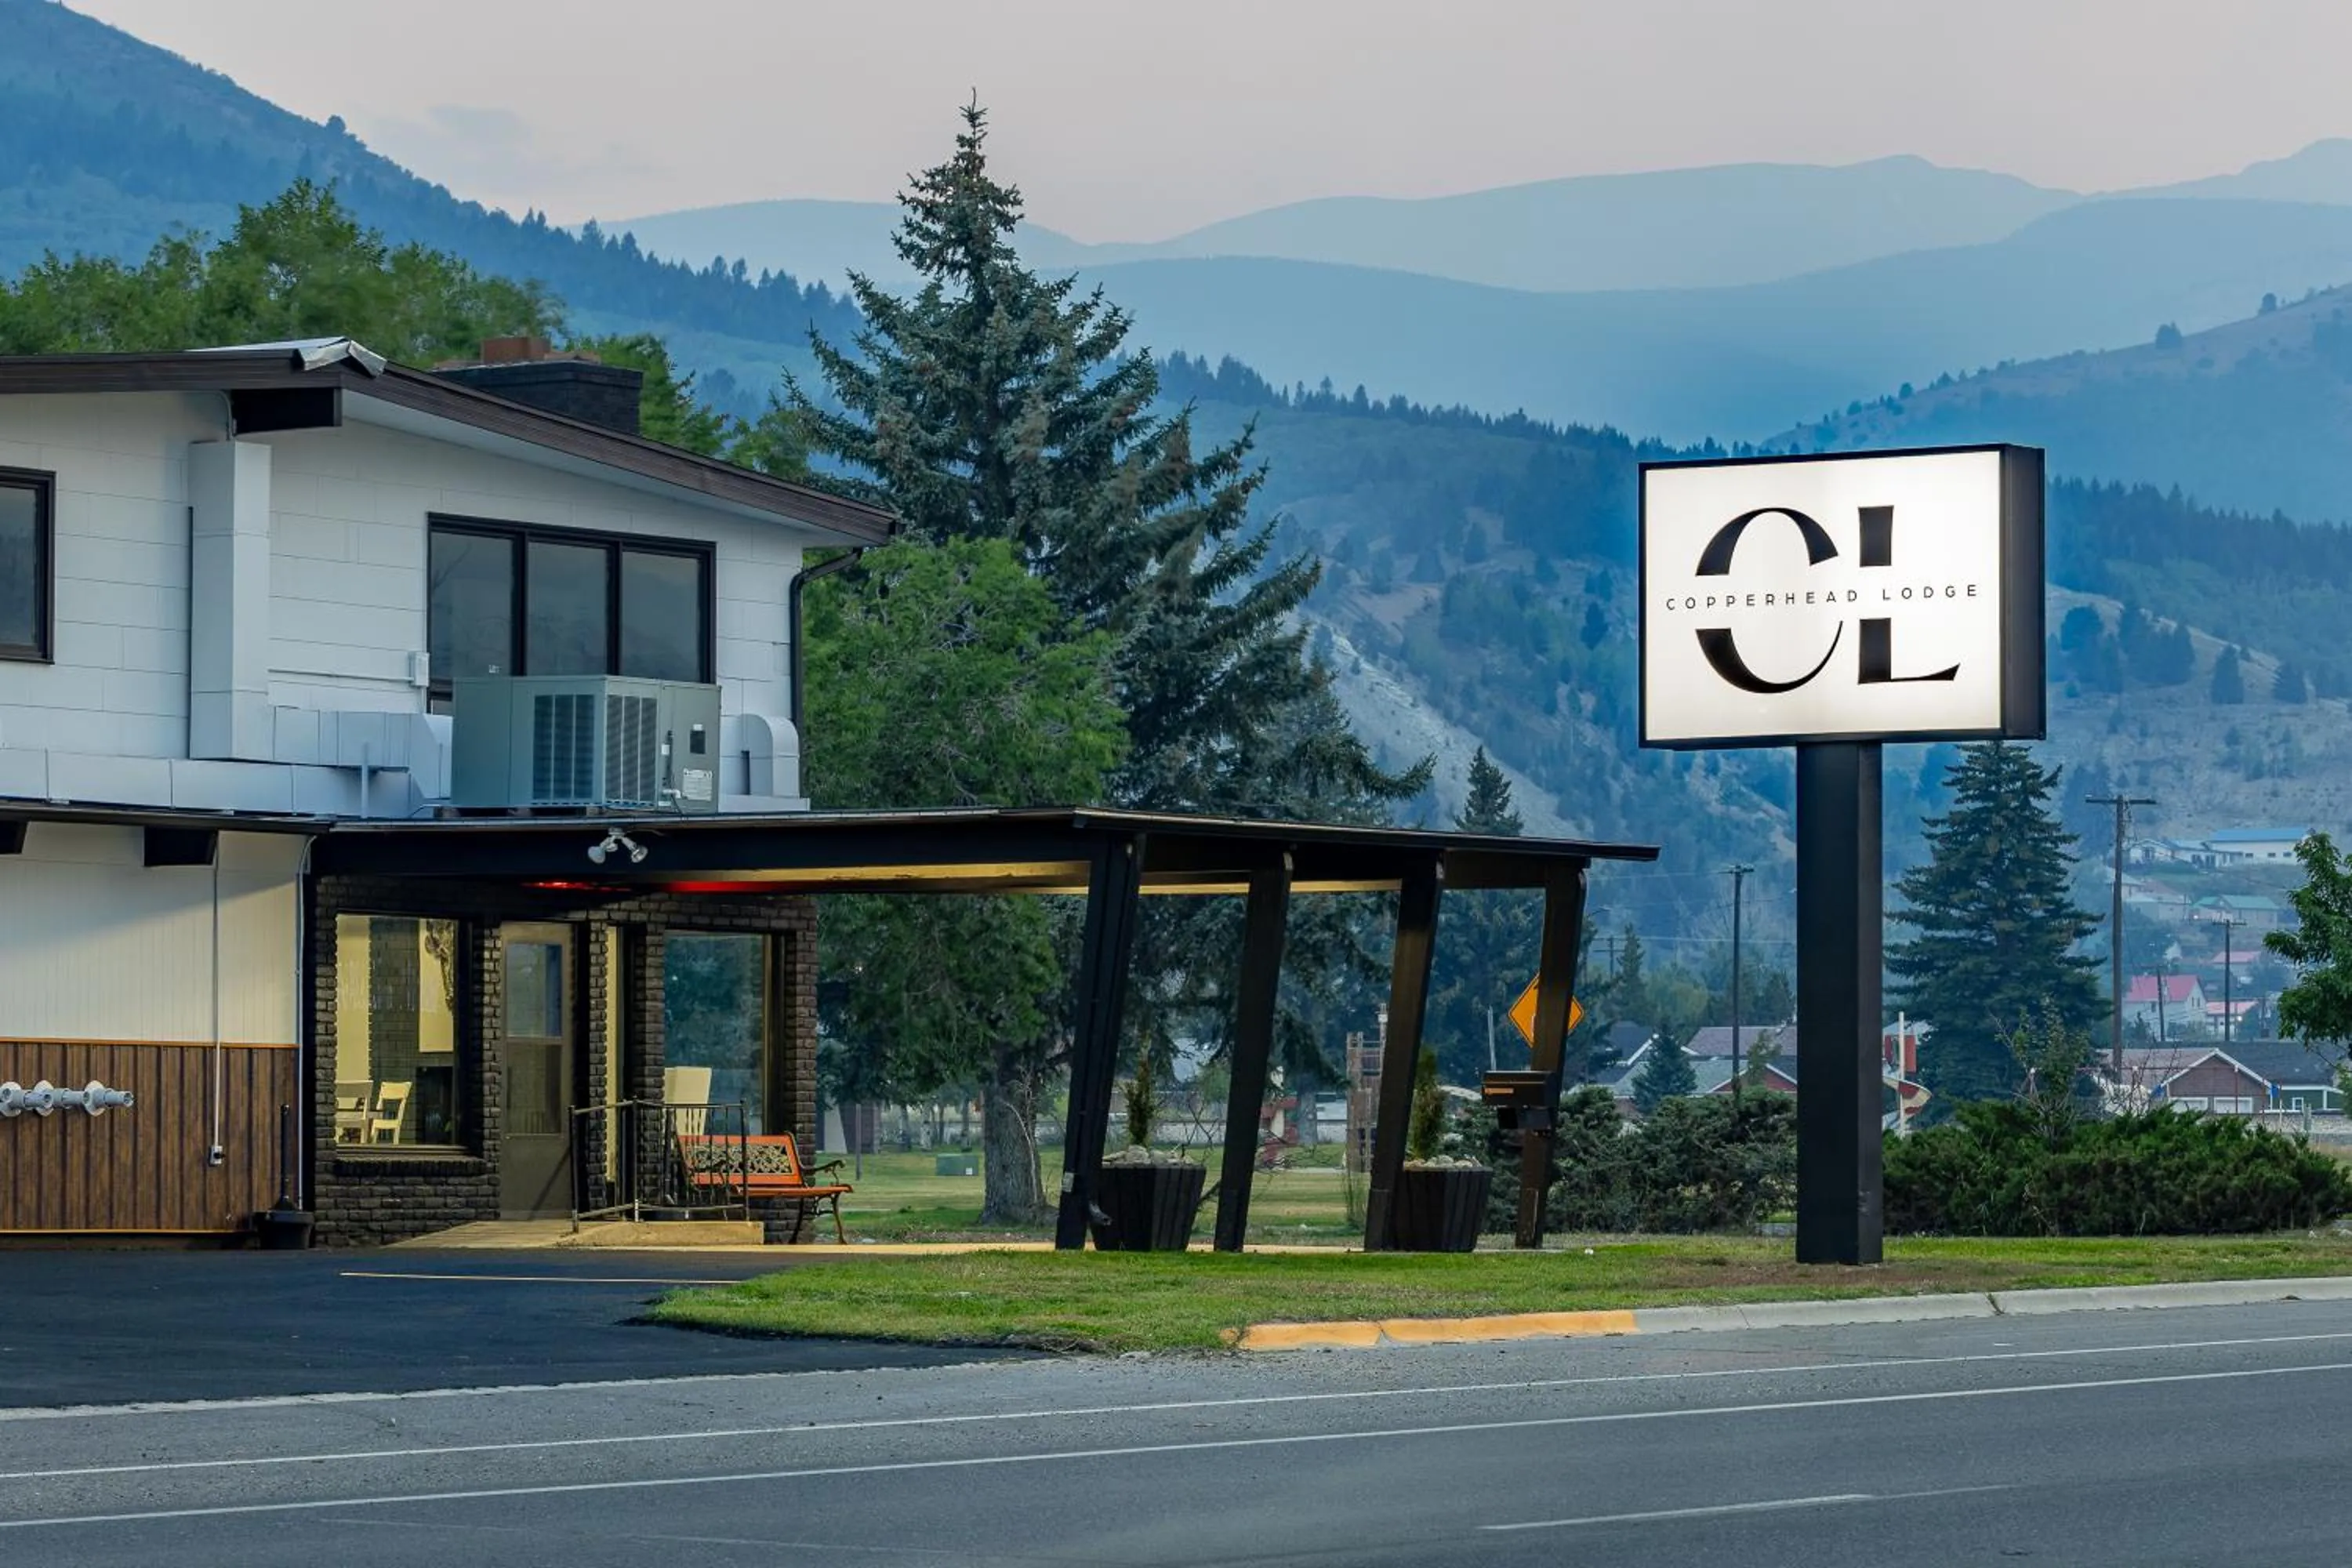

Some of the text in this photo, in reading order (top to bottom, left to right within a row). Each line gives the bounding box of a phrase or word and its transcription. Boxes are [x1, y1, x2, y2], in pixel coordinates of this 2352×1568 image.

[1666, 584, 1977, 611] COPPERHEAD LODGE
[1696, 505, 1961, 694] CL
